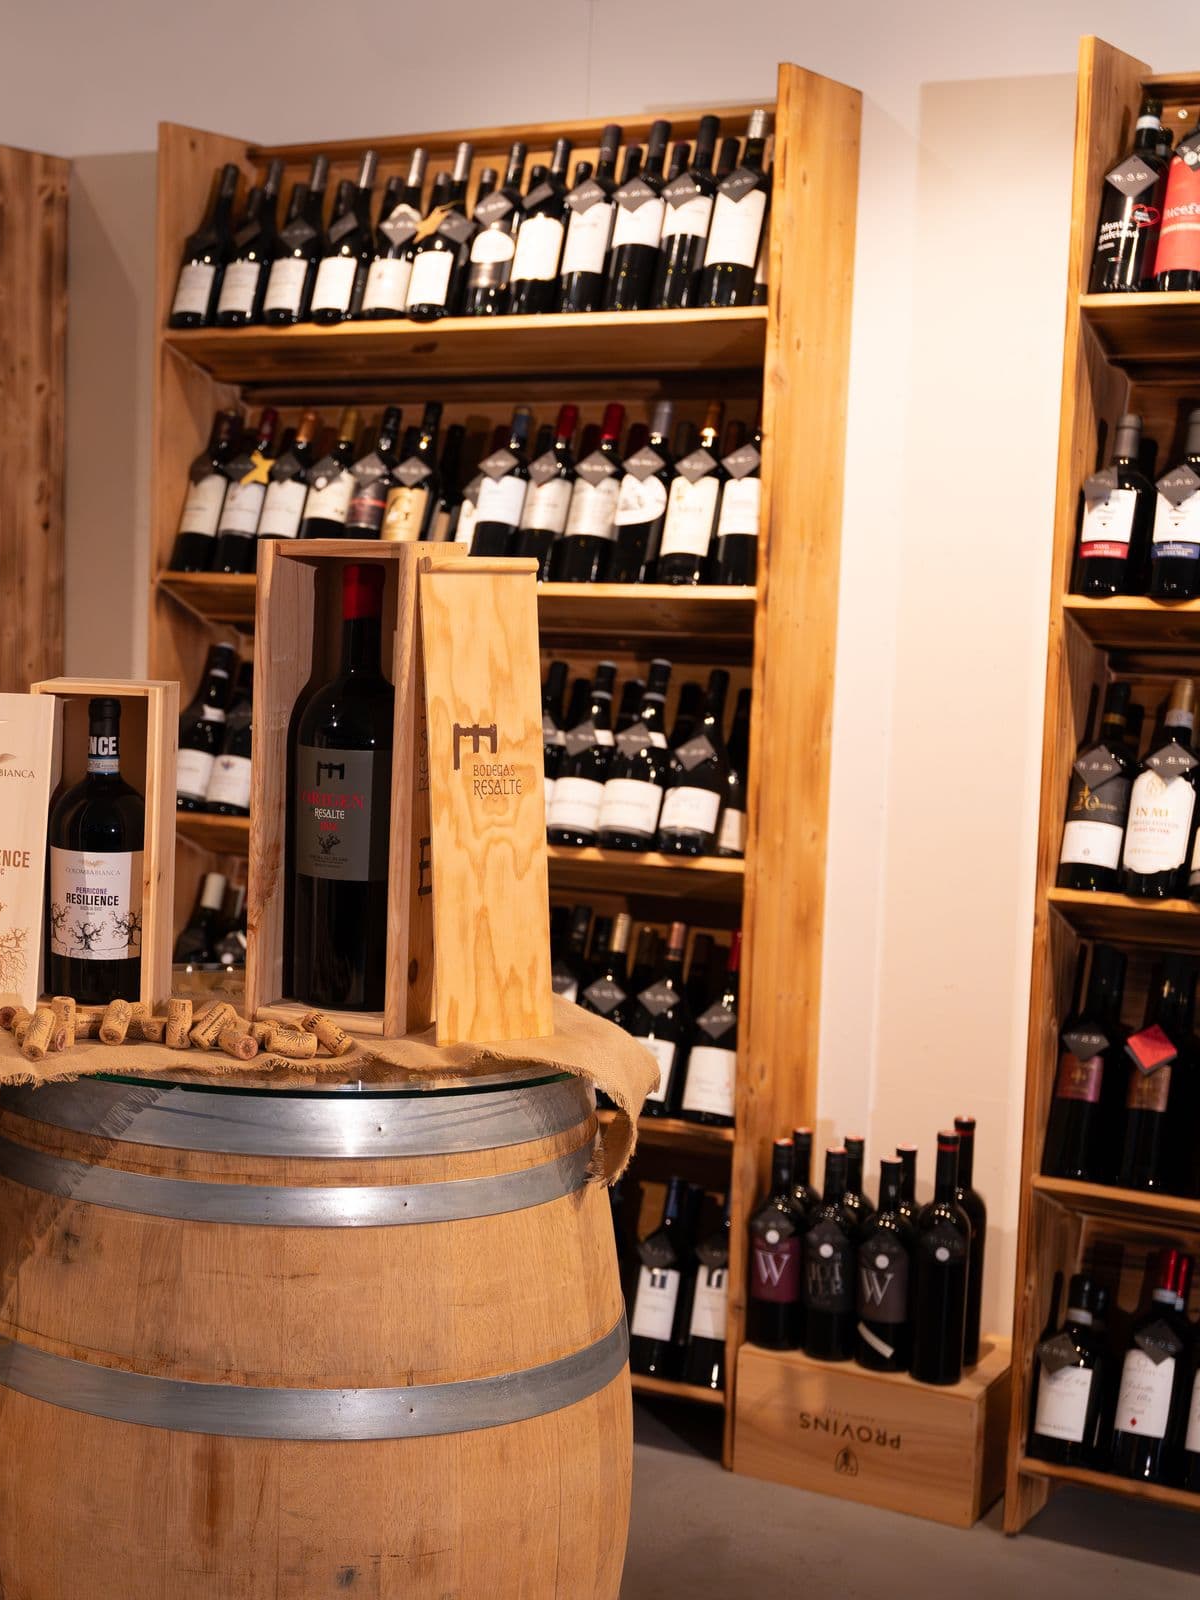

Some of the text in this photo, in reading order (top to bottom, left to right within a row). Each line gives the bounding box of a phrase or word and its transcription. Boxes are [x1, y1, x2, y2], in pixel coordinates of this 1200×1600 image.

[473, 764, 516, 777] BODEGAS
[473, 779, 523, 800] RESALTE
[314, 807, 345, 820] RESALTE
[66, 892, 120, 906] RESILIENCE
[756, 1250, 792, 1287] W
[862, 1268, 895, 1306] W
[799, 1411, 901, 1451] PROVINS
